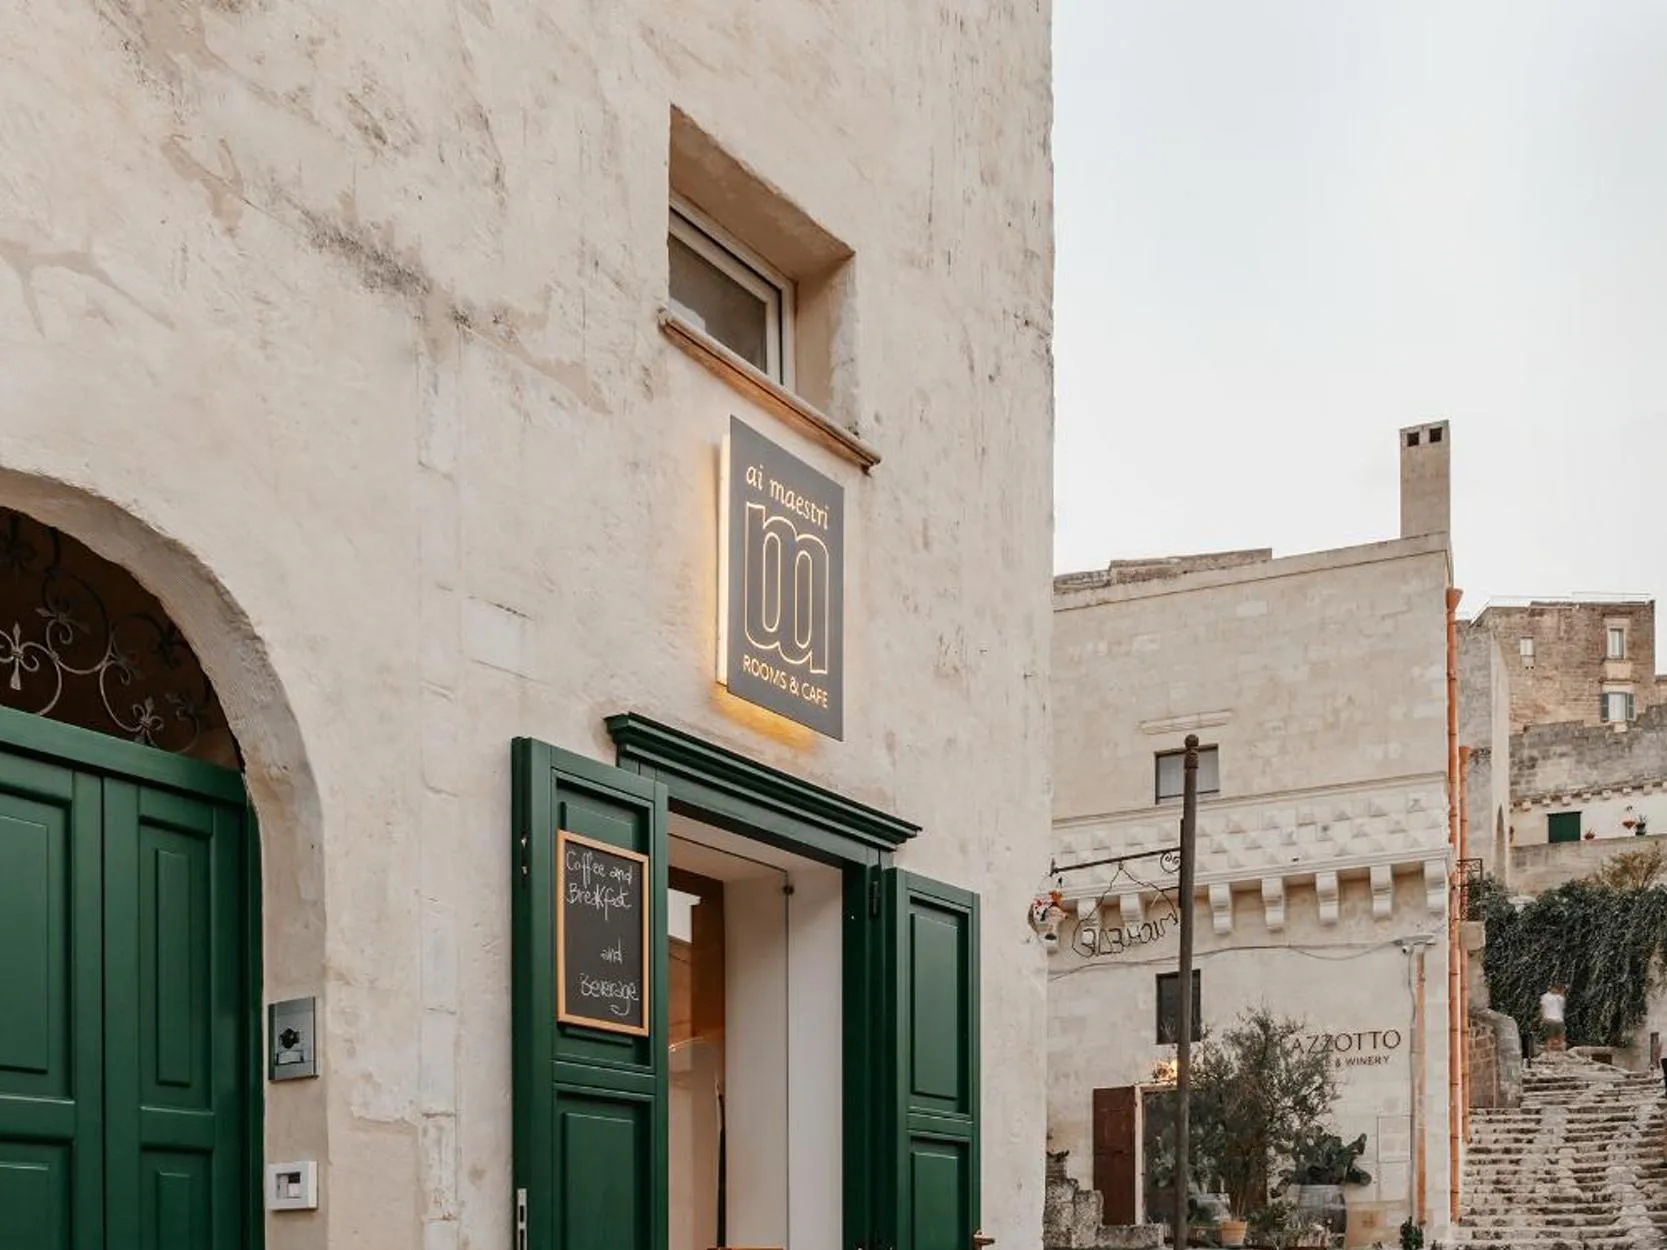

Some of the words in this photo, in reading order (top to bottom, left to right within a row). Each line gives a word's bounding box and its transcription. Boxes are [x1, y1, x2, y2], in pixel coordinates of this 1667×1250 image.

[746, 464, 764, 490] ai
[769, 479, 829, 530] maestri
[743, 653, 788, 690] ROOMS
[789, 675, 799, 696] &
[566, 851, 605, 889] Coffee
[609, 865, 632, 886] and
[601, 936, 623, 964] and
[1292, 1029, 1401, 1054] AZZOTTO
[1345, 1055, 1390, 1067] WINERY
